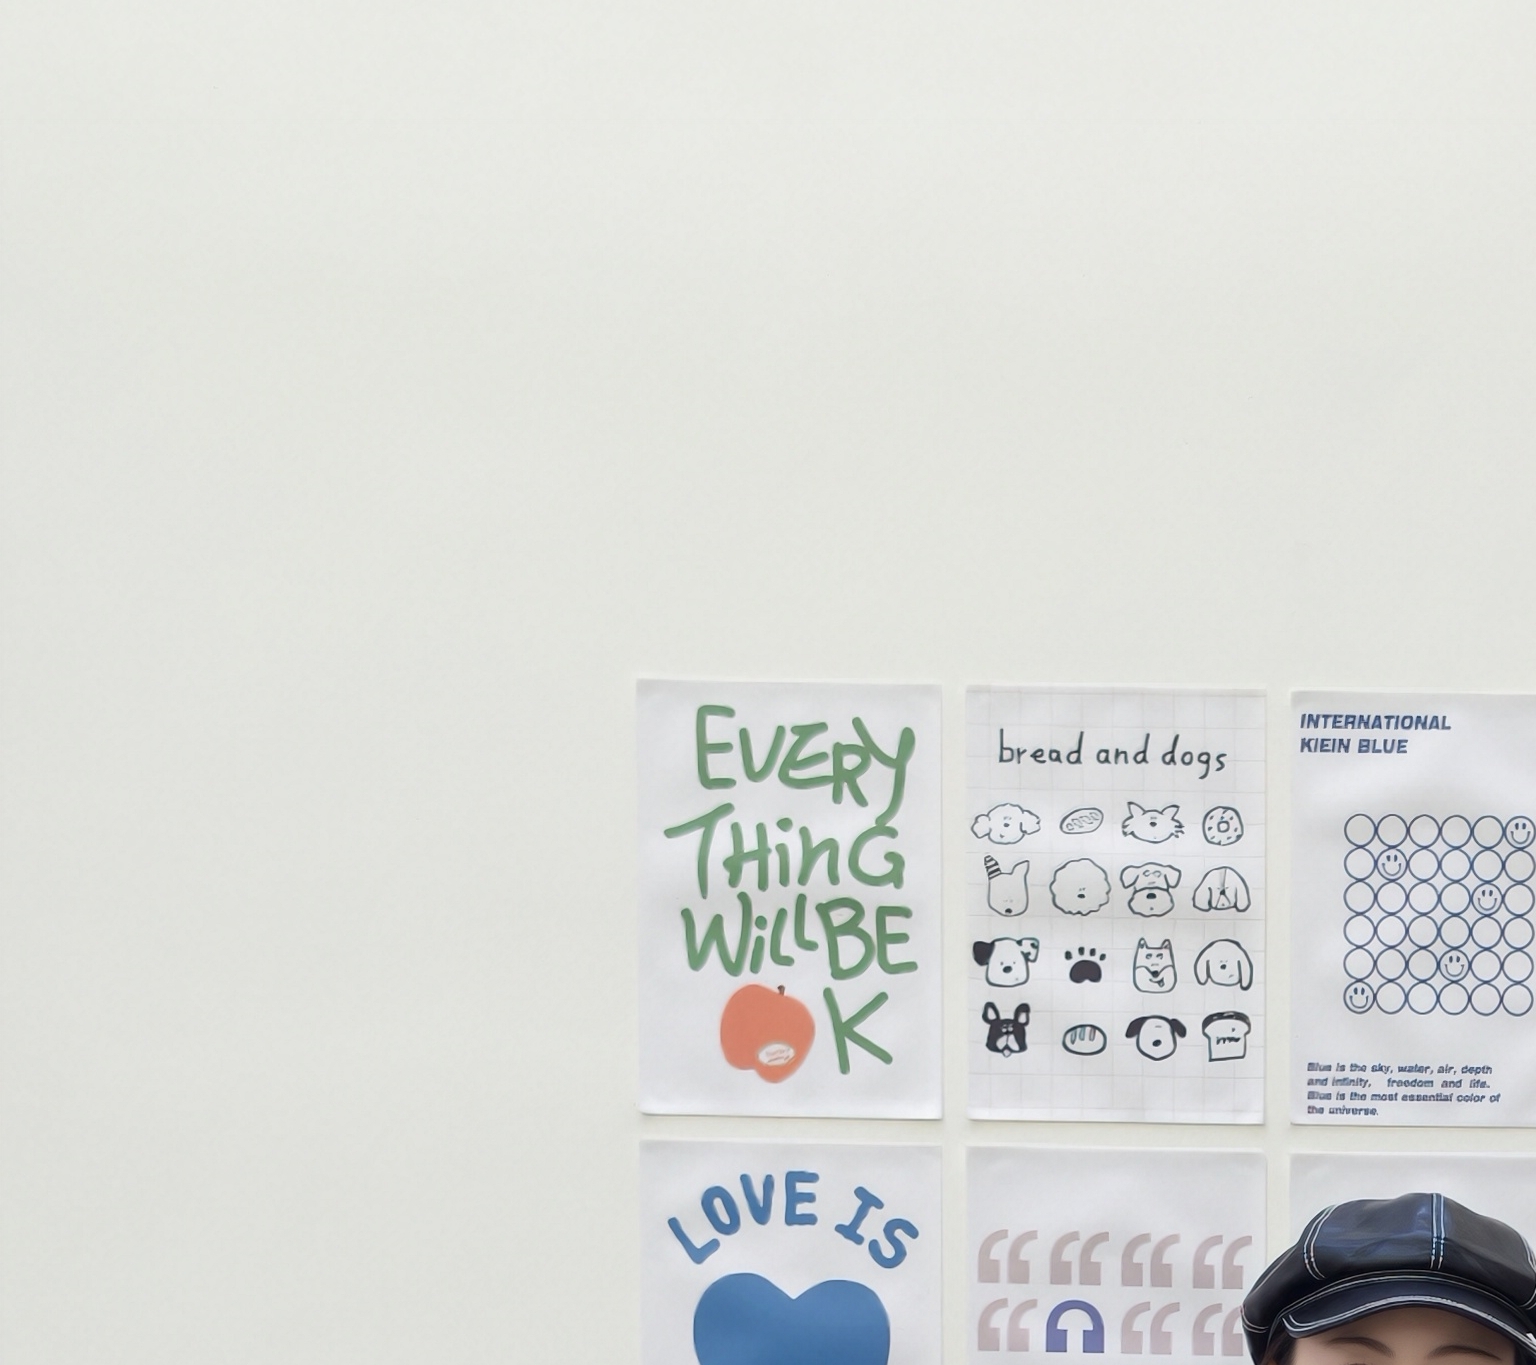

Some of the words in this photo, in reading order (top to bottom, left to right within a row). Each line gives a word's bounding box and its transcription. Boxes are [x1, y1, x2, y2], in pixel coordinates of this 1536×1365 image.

[1299, 713, 1452, 730] INTERNATIONAL
[1358, 739, 1408, 753] BLUE
[999, 728, 1085, 765] bread
[1096, 733, 1150, 766] and
[1161, 733, 1227, 780] dogs
[696, 705, 916, 826] EVERY
[815, 896, 918, 980] BE
[1307, 1063, 1331, 1072] Blue
[1336, 1063, 1345, 1072] is
[1350, 1063, 1366, 1072] the
[1371, 1063, 1393, 1075] sky,
[1398, 1065, 1433, 1075] water,
[1437, 1064, 1457, 1075] air,
[1461, 1065, 1492, 1076] depth
[1307, 1077, 1328, 1086] and
[1332, 1077, 1371, 1088] infinity,
[1387, 1078, 1434, 1088] freedom
[1441, 1079, 1462, 1088] and
[1469, 1079, 1490, 1088] life.
[1307, 1091, 1331, 1100] Blue
[1336, 1091, 1345, 1101] is
[1350, 1091, 1366, 1101] the
[1371, 1093, 1398, 1101] most
[1402, 1093, 1453, 1102] essential
[1457, 1093, 1485, 1103] color
[1490, 1093, 1501, 1103] of
[1307, 1106, 1324, 1115] the
[1329, 1107, 1378, 1116] universe.
[667, 1171, 819, 1264] LOVE
[834, 1186, 919, 1269] IS
